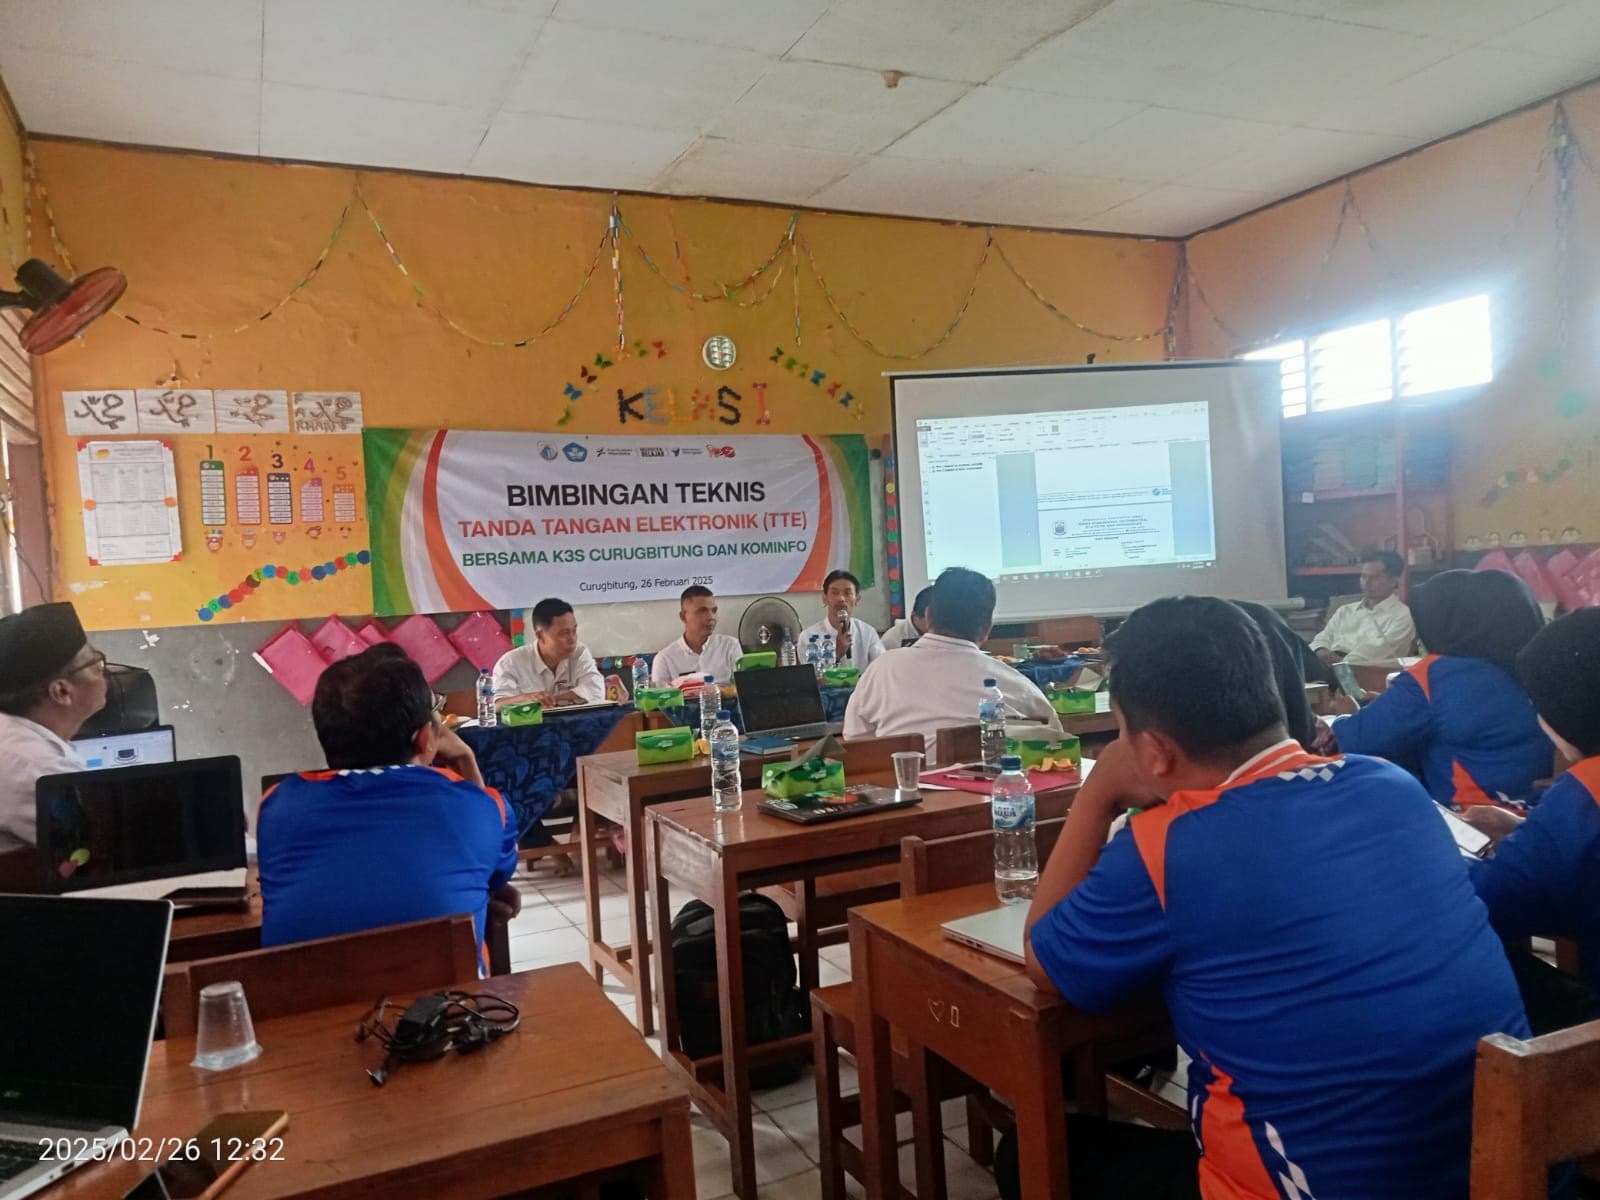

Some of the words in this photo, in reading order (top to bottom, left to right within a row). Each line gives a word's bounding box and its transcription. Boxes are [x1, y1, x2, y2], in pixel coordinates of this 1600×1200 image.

[617, 385, 742, 425] KELAS
[206, 444, 213, 460] 1
[238, 446, 253, 462] 2
[271, 453, 284, 469] 3
[304, 458, 316, 473] 4
[336, 466, 347, 481] 5
[506, 483, 668, 507] BIMBINGAN
[675, 481, 765, 503] TEKNIS
[458, 519, 536, 538] TANDA
[541, 516, 631, 535] TANGAN
[636, 513, 759, 532] ELEKTRONIK
[763, 511, 807, 531] (TTE)
[462, 551, 548, 567] BERSAMA
[553, 549, 585, 563] K3S
[589, 544, 703, 562] CURUGBITUNG
[707, 543, 740, 557] DAN
[741, 540, 807, 555] KOMINFO
[579, 579, 638, 592] Curugbitung,
[641, 578, 652, 589] 26
[655, 576, 689, 588] Februari
[692, 575, 714, 586] 2025
